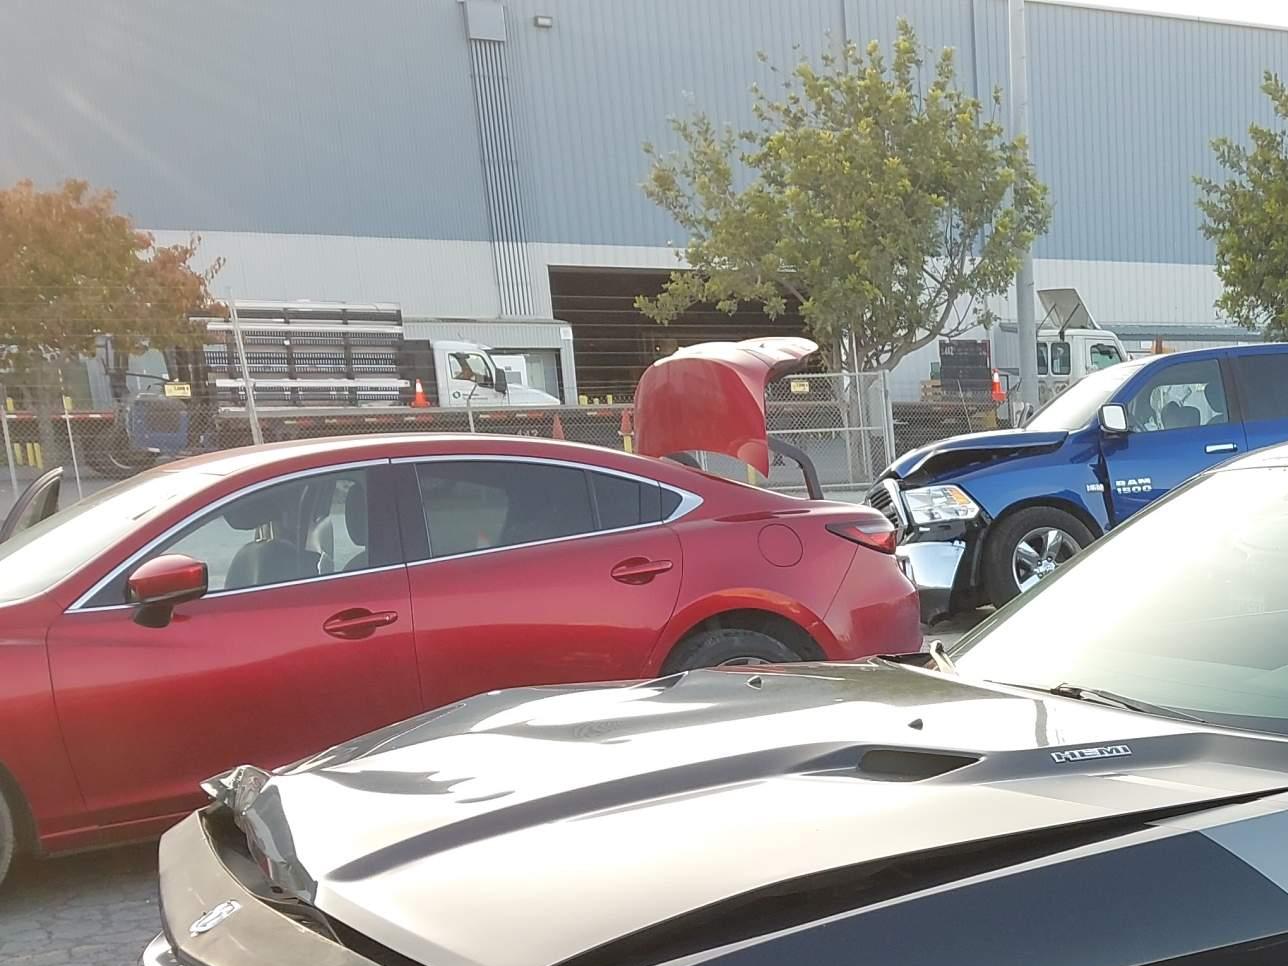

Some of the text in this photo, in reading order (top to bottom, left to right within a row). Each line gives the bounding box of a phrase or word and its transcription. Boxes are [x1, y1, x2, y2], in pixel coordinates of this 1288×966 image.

[1115, 477, 1152, 487] RAM
[1115, 485, 1153, 495] 1500
[1050, 744, 1133, 763] HEMI
